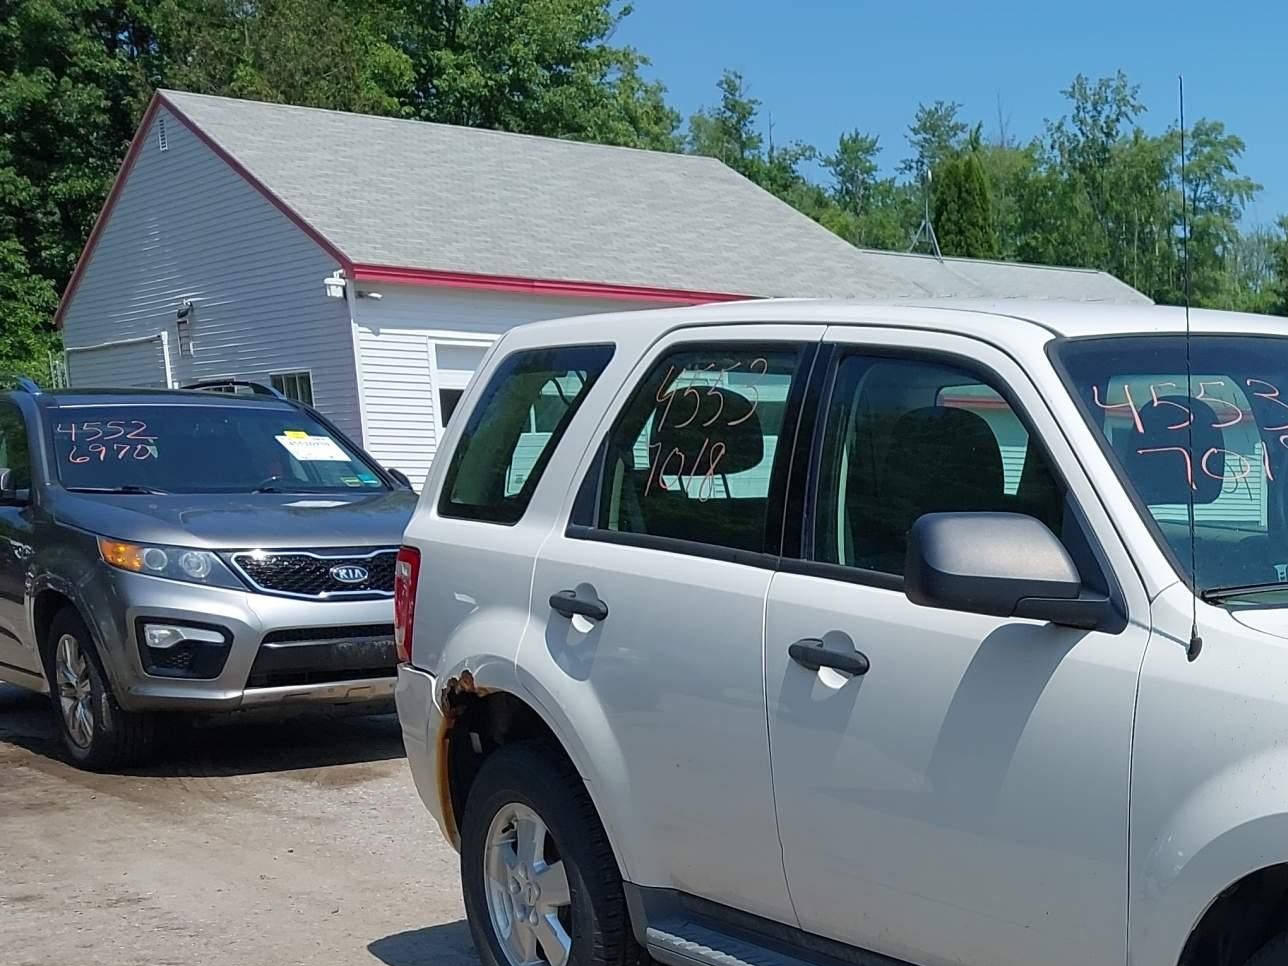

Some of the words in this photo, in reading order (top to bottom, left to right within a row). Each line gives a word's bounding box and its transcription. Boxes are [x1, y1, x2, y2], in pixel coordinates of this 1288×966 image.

[656, 357, 768, 433] 4553
[57, 420, 159, 442] 4552
[68, 443, 152, 463] 6970
[644, 437, 726, 503] 7018
[338, 568, 364, 580] KIA
